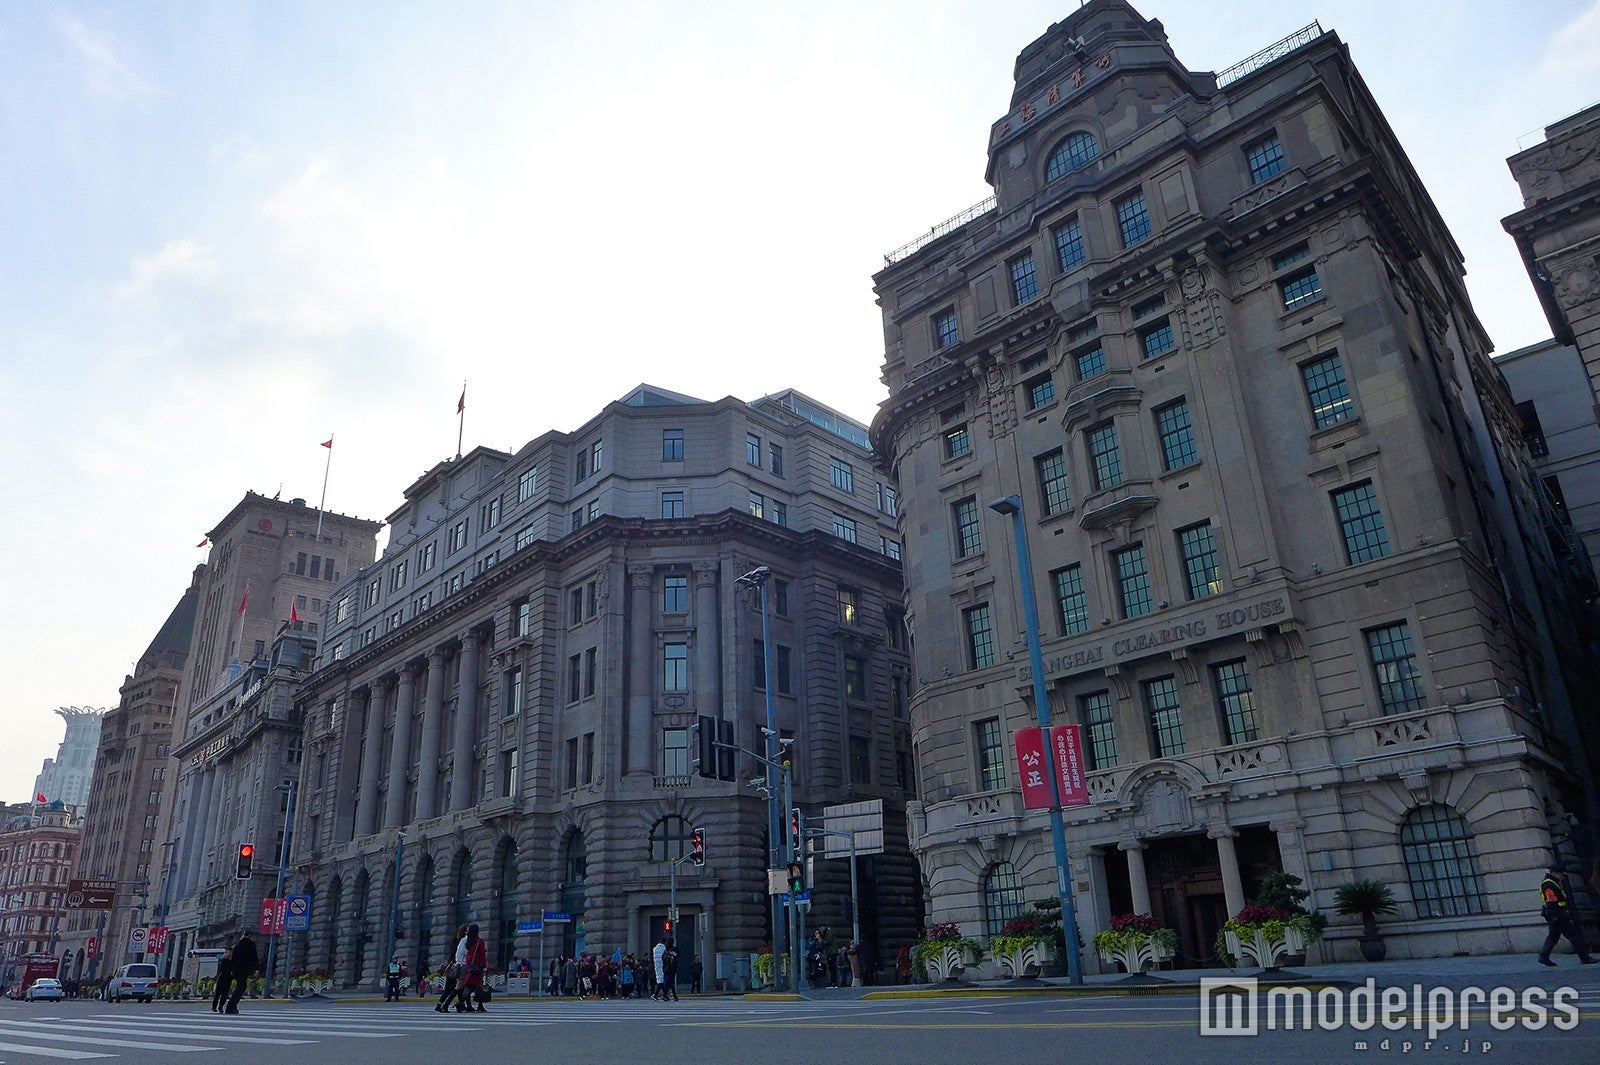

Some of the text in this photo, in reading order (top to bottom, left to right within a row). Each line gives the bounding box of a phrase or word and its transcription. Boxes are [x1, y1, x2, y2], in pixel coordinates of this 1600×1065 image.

[1112, 620, 1207, 656] CLEARING
[1215, 598, 1286, 630] HOUSE
[1022, 750, 1043, 788] 公正
